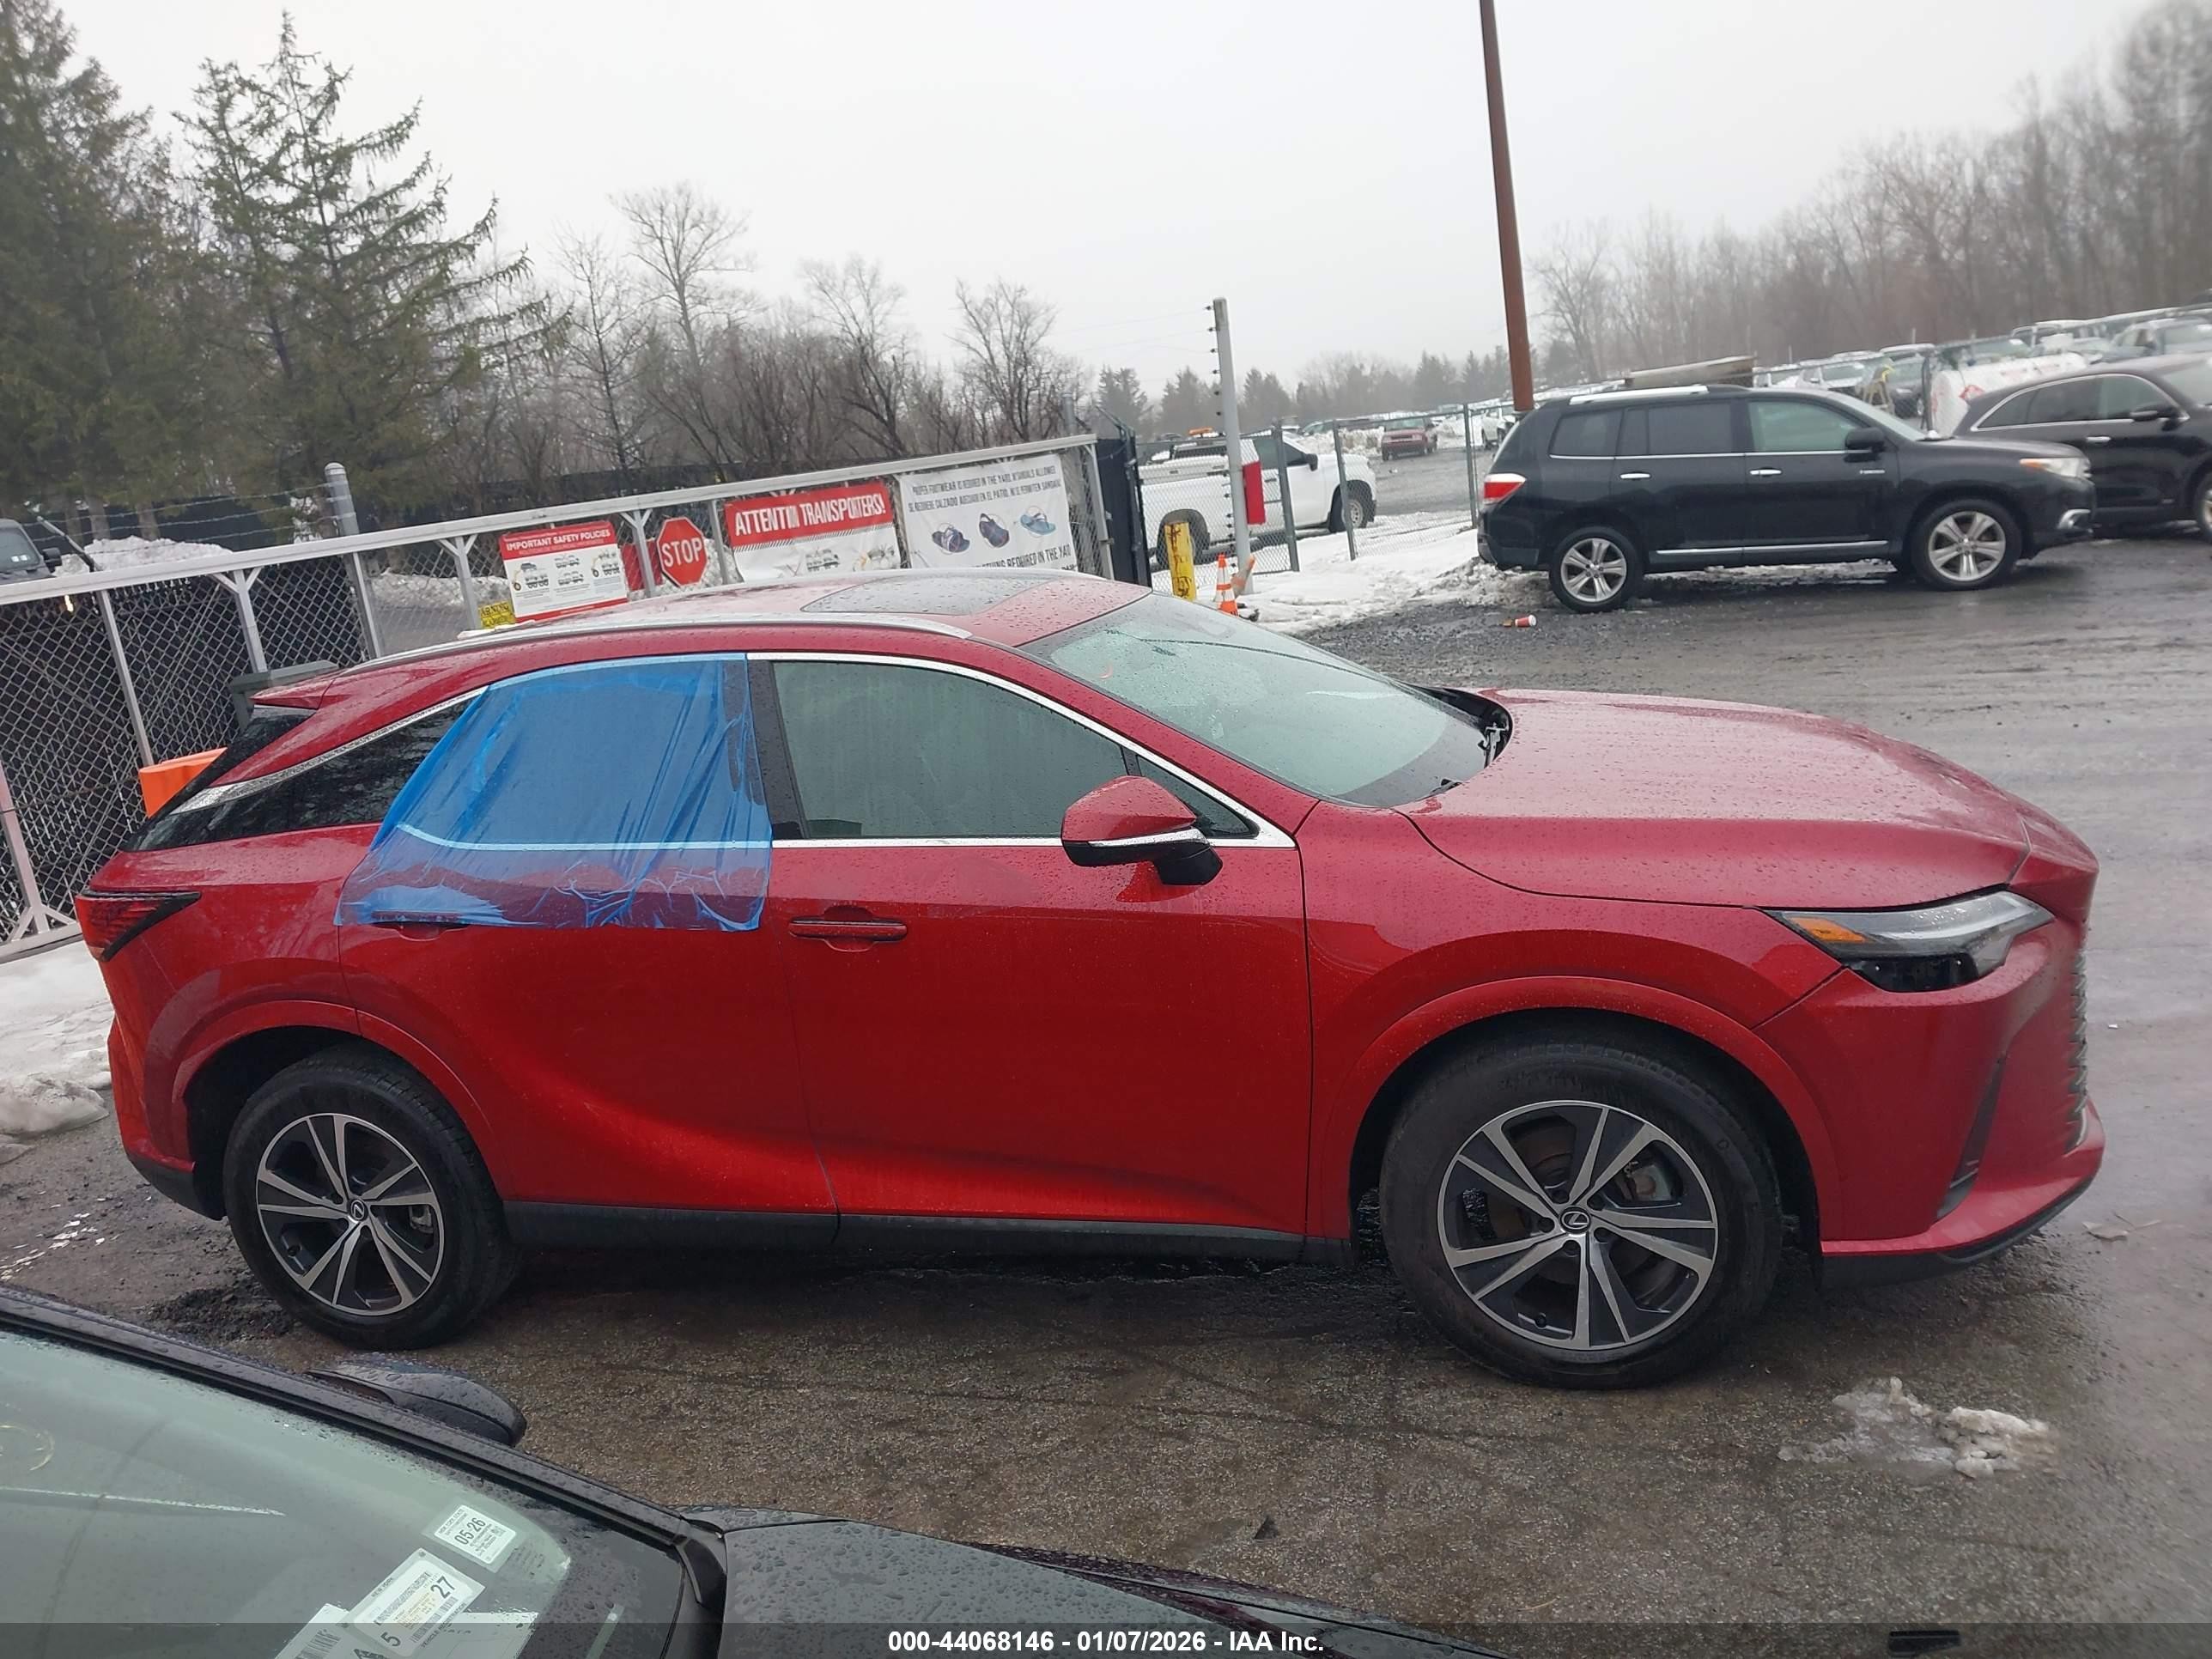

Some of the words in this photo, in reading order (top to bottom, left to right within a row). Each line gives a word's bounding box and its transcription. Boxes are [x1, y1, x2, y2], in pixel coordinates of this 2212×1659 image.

[507, 538, 552, 551] IMPORTANT
[552, 533, 580, 544] SAFETY
[580, 529, 611, 540] POLICIES
[661, 538, 703, 568] STOP
[1045, 547, 1058, 562] THE
[382, 1577, 393, 1588] YORK
[430, 1575, 455, 1598] 27
[380, 1632, 401, 1647] 5
